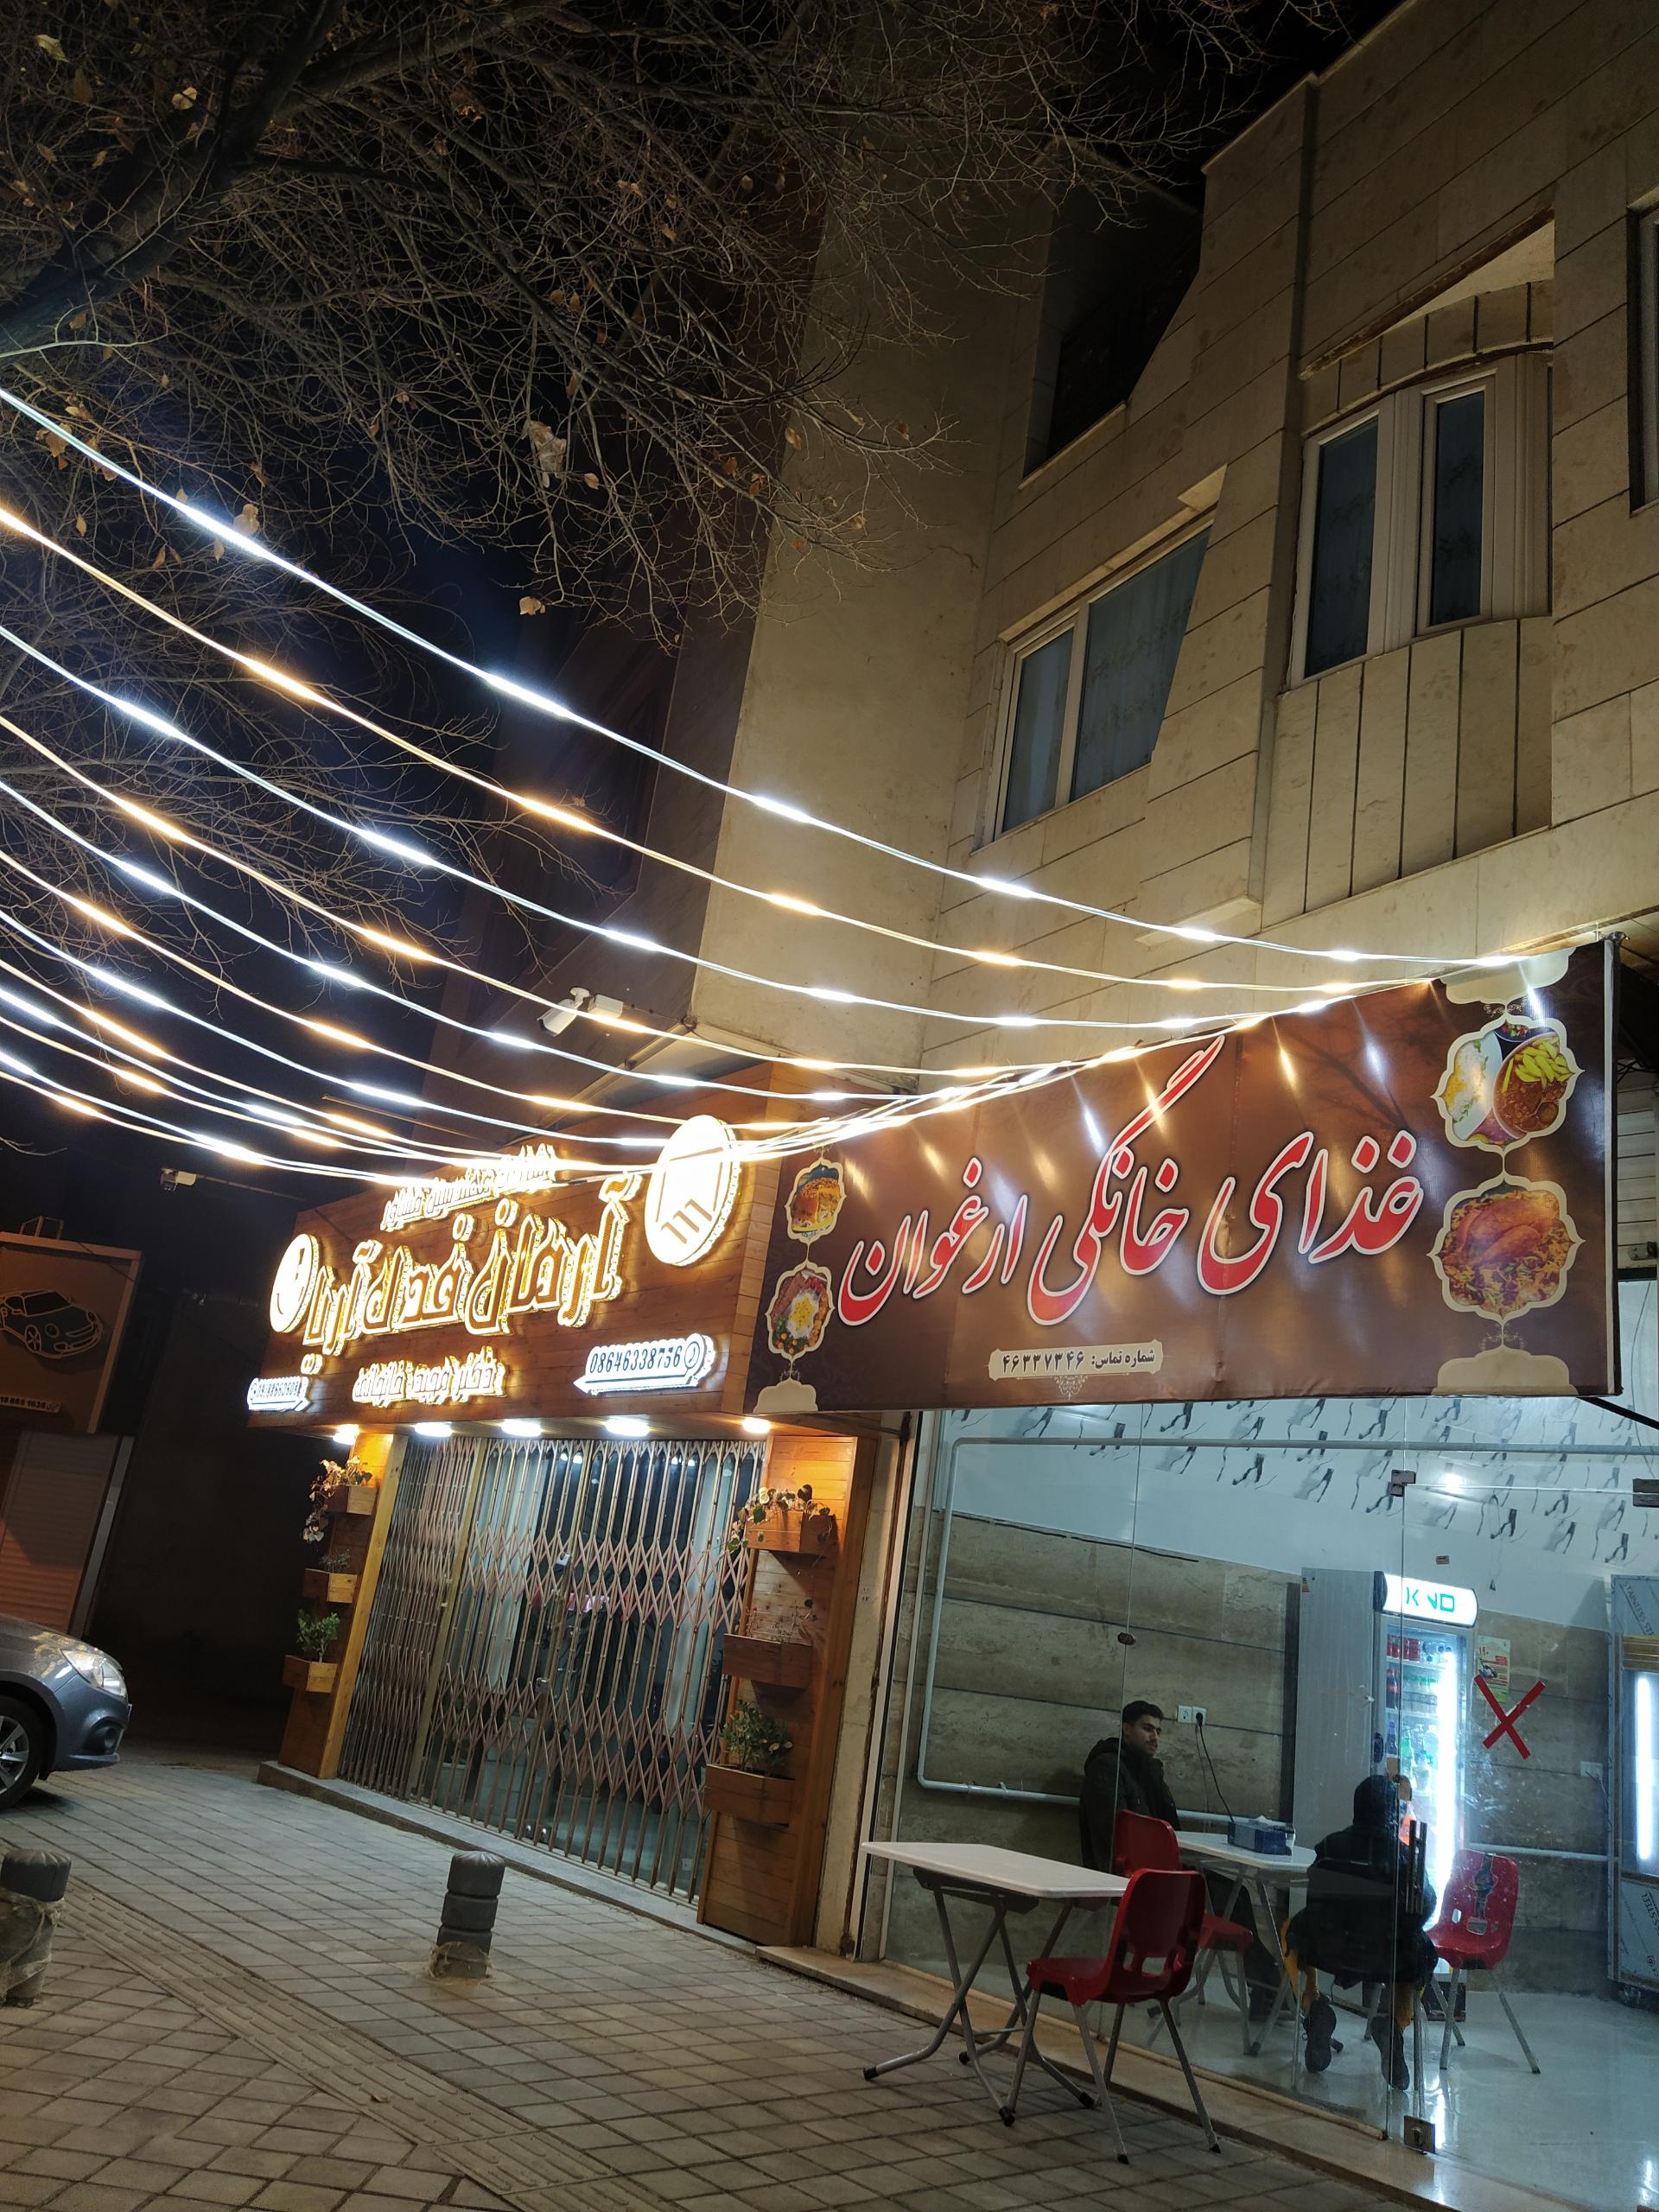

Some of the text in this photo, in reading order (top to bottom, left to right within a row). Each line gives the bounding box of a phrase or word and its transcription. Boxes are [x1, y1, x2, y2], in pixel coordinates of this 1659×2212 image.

[837, 1034, 1426, 1329] غذای خانگی ارغوان
[465, 1173, 644, 1337] آرمان
[589, 1345, 683, 1374] 08646338756
[1001, 1349, 1156, 1375] شماره تماس: ۴۶۳۳۷۳۴۶
